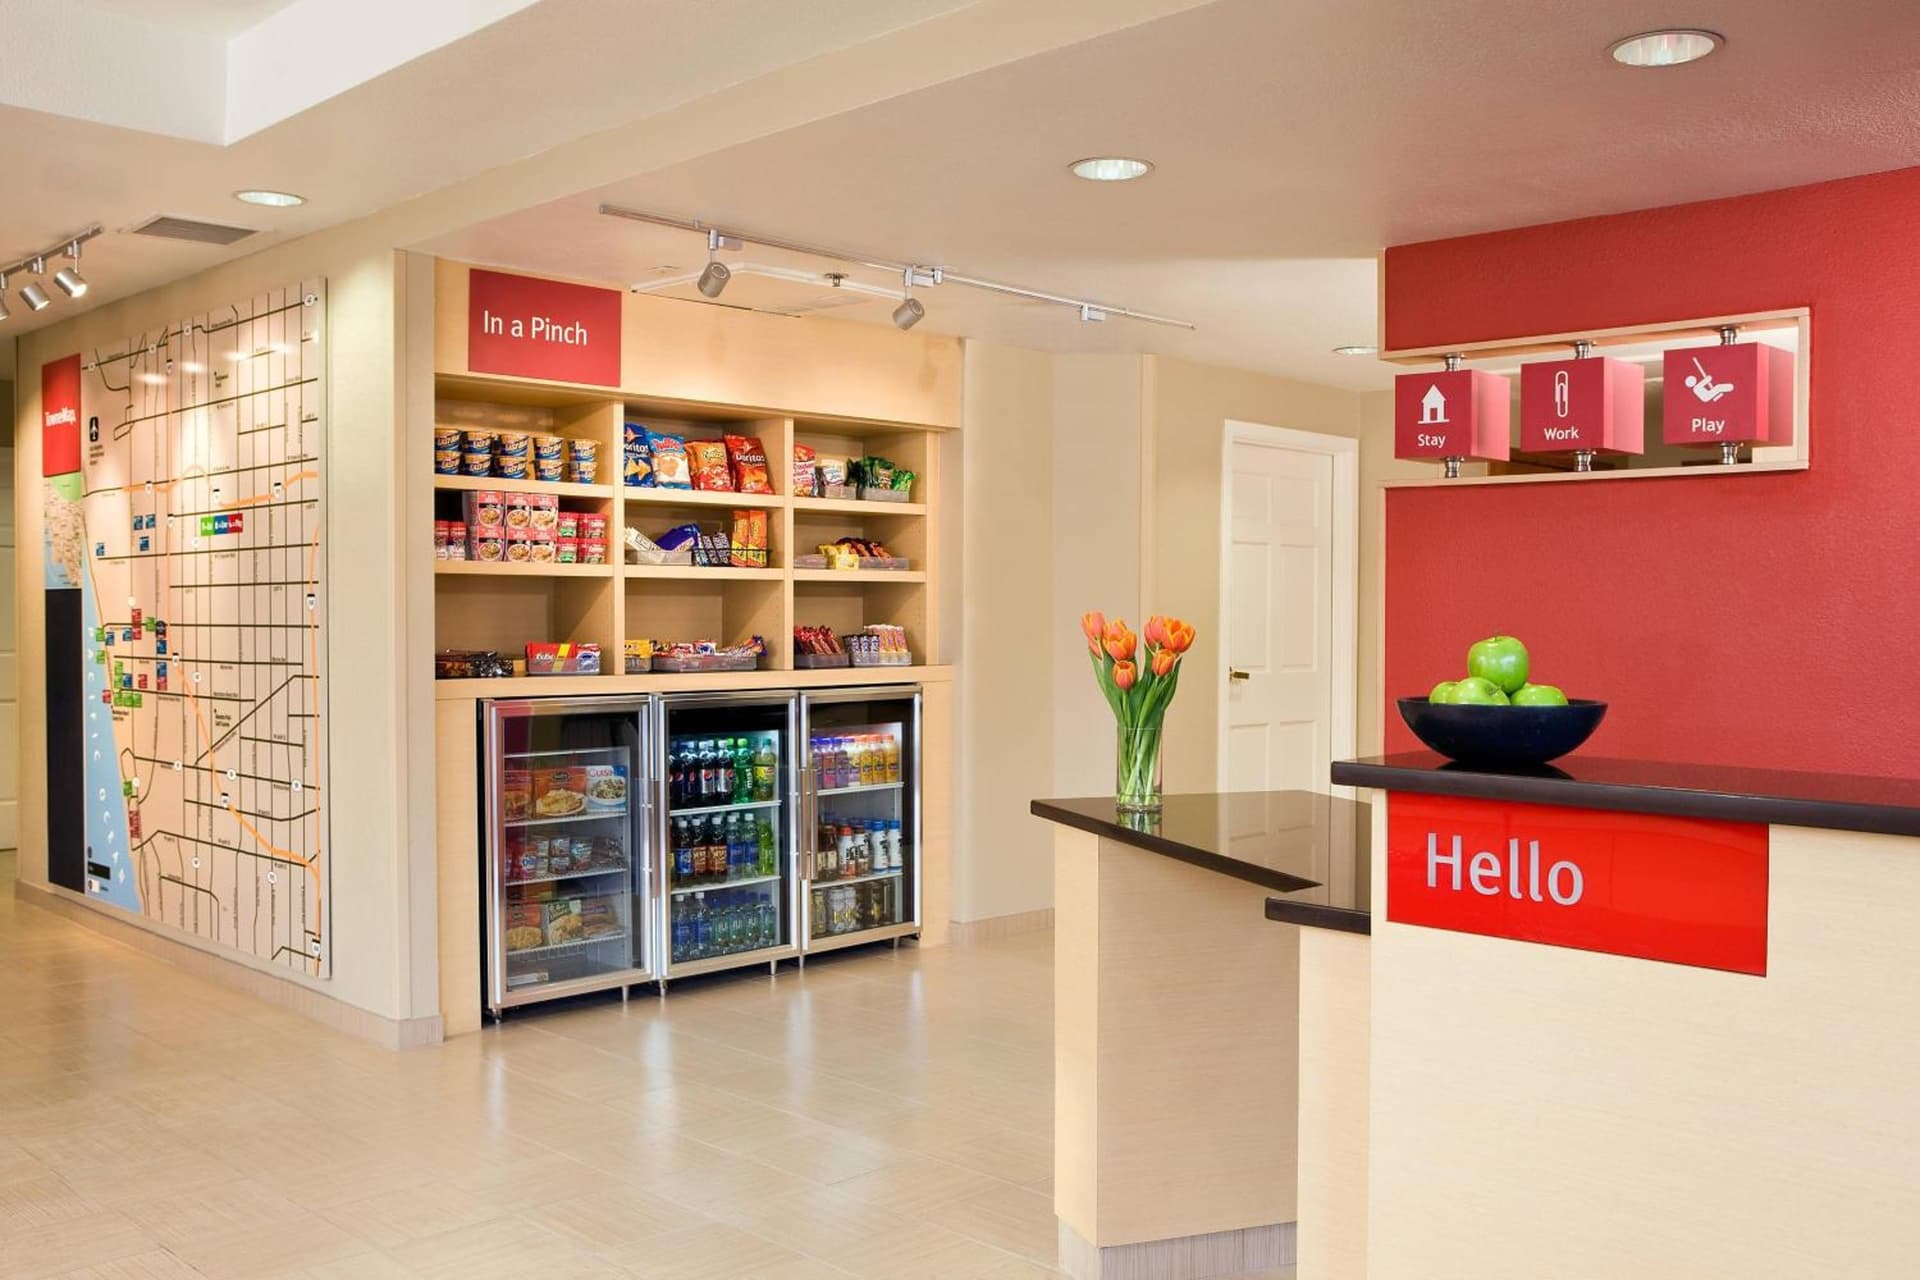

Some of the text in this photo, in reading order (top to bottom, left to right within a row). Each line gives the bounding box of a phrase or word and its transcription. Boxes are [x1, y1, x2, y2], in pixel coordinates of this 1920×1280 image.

[484, 310, 588, 346] In a Pinch
[1543, 425, 1579, 441] Work
[1692, 417, 1726, 435] Play
[625, 443, 649, 453] oritos
[1417, 433, 1446, 449] Stay
[735, 453, 766, 463] Doritos
[1425, 832, 1585, 906] Hello
